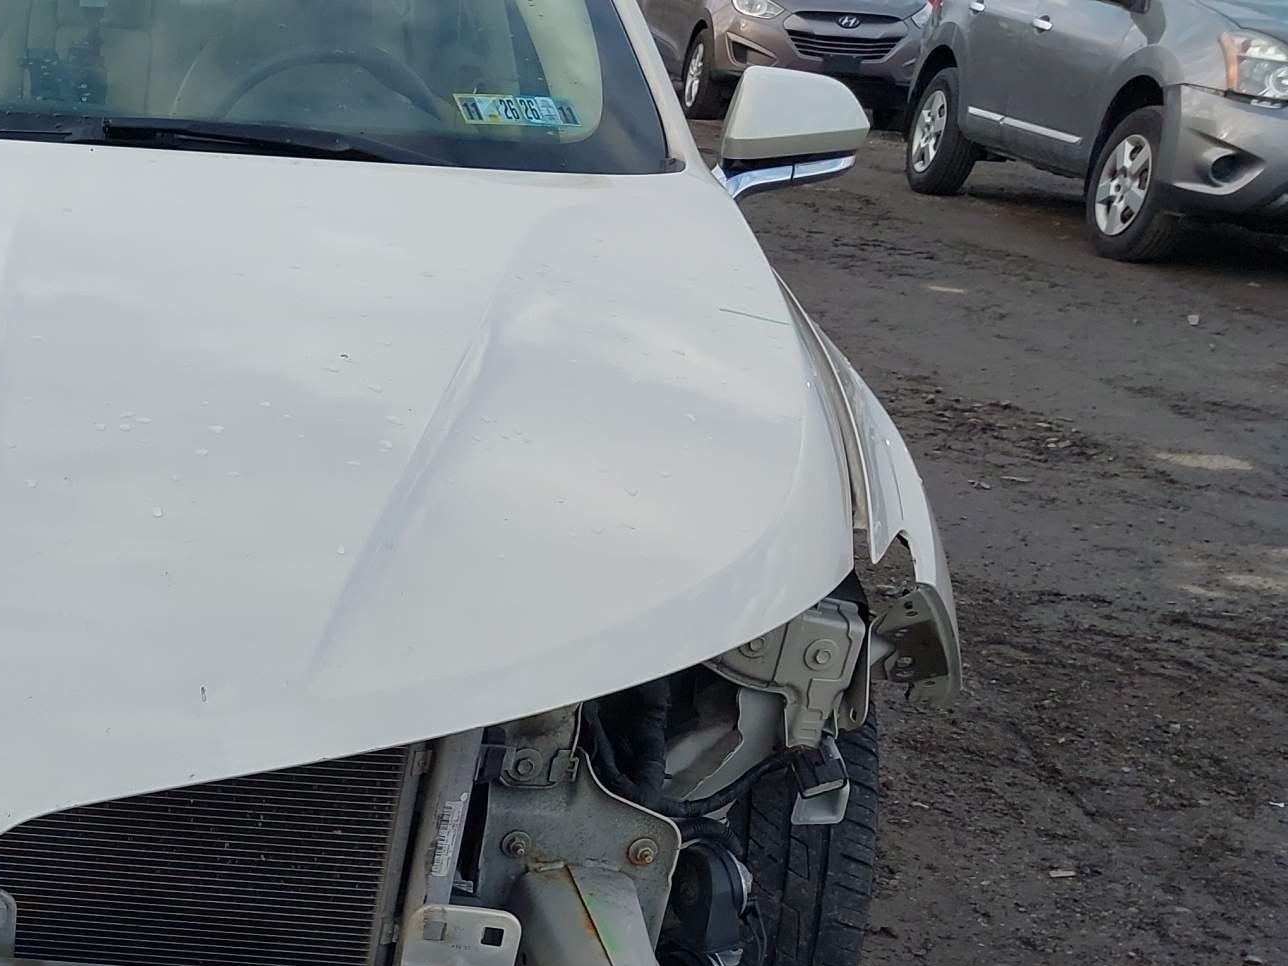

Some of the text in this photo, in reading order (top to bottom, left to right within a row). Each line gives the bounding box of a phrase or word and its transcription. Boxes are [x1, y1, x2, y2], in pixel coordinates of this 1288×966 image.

[462, 102, 484, 121] 11
[499, 99, 520, 120] 26
[520, 99, 541, 121] 26
[558, 105, 579, 125] 11
